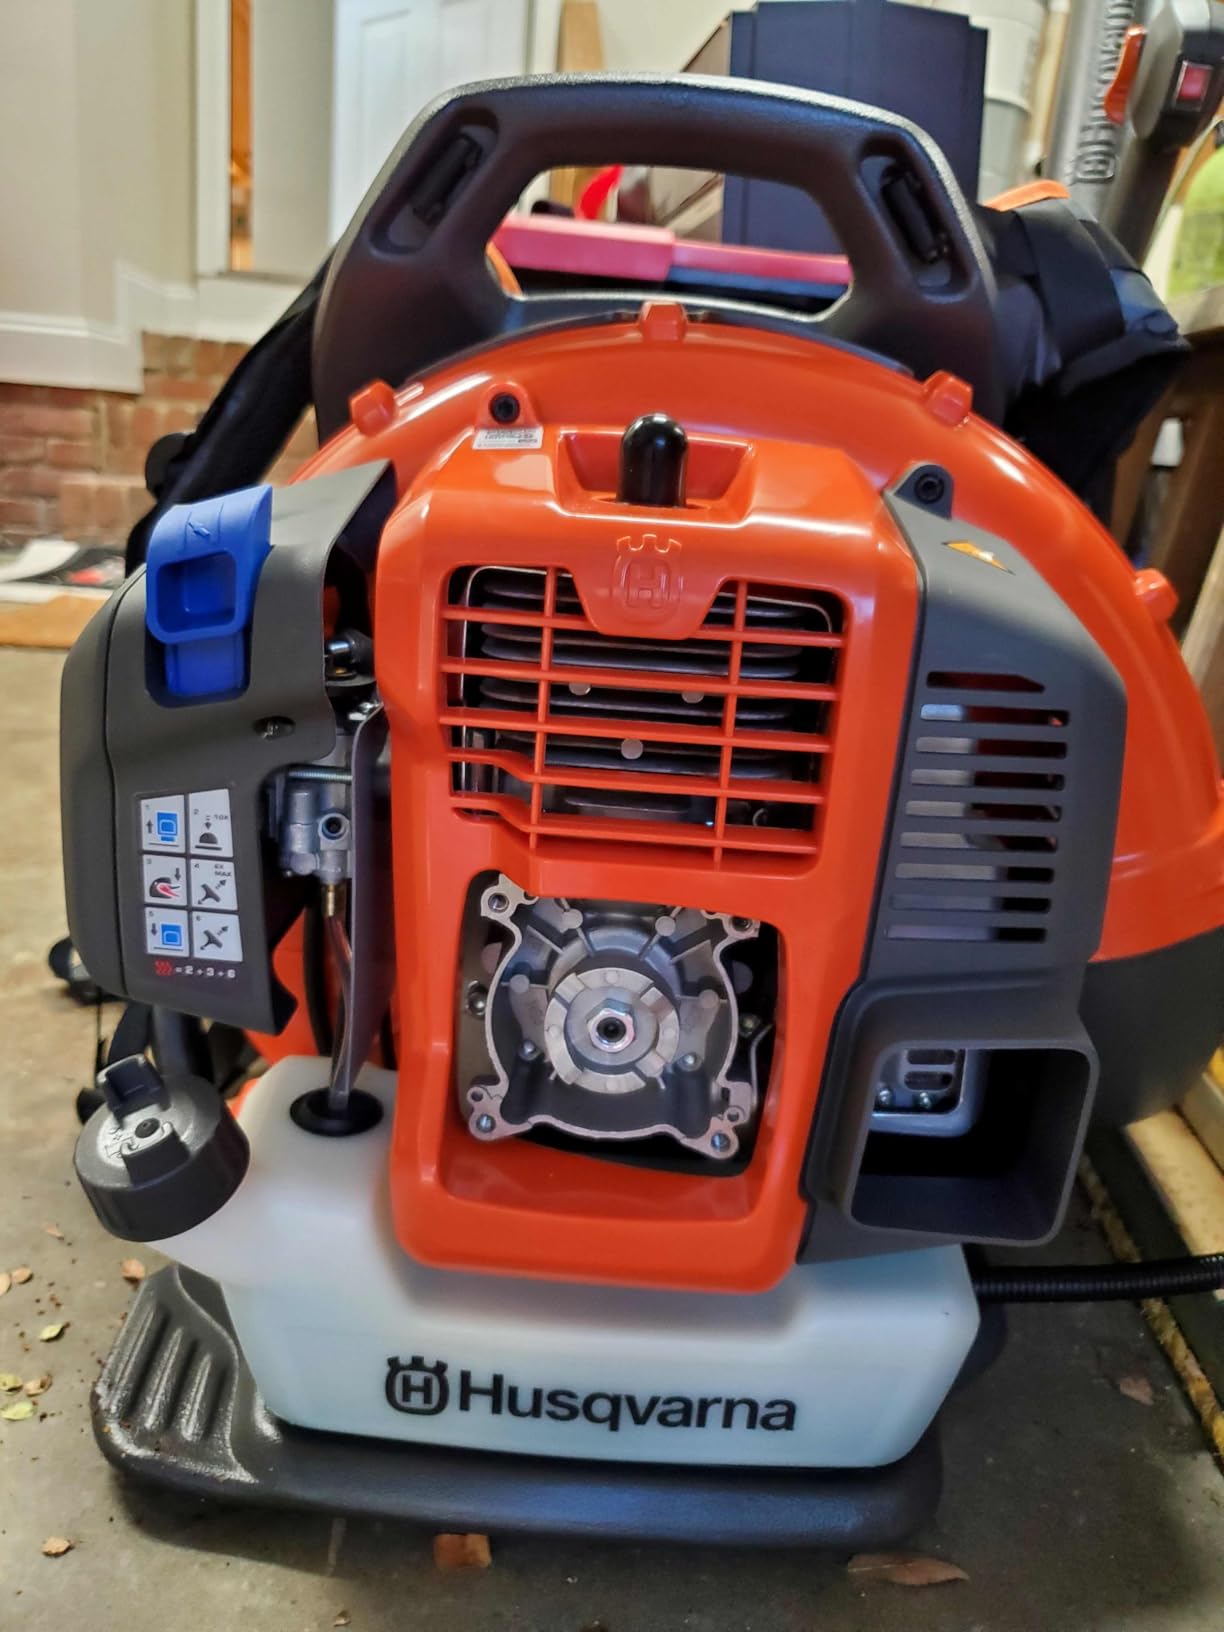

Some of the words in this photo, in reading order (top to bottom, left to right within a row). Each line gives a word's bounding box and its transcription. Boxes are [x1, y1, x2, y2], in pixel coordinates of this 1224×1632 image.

[184, 965, 194, 975] 2
[206, 967, 214, 977] 3
[458, 1370, 797, 1432] Husqvarna
